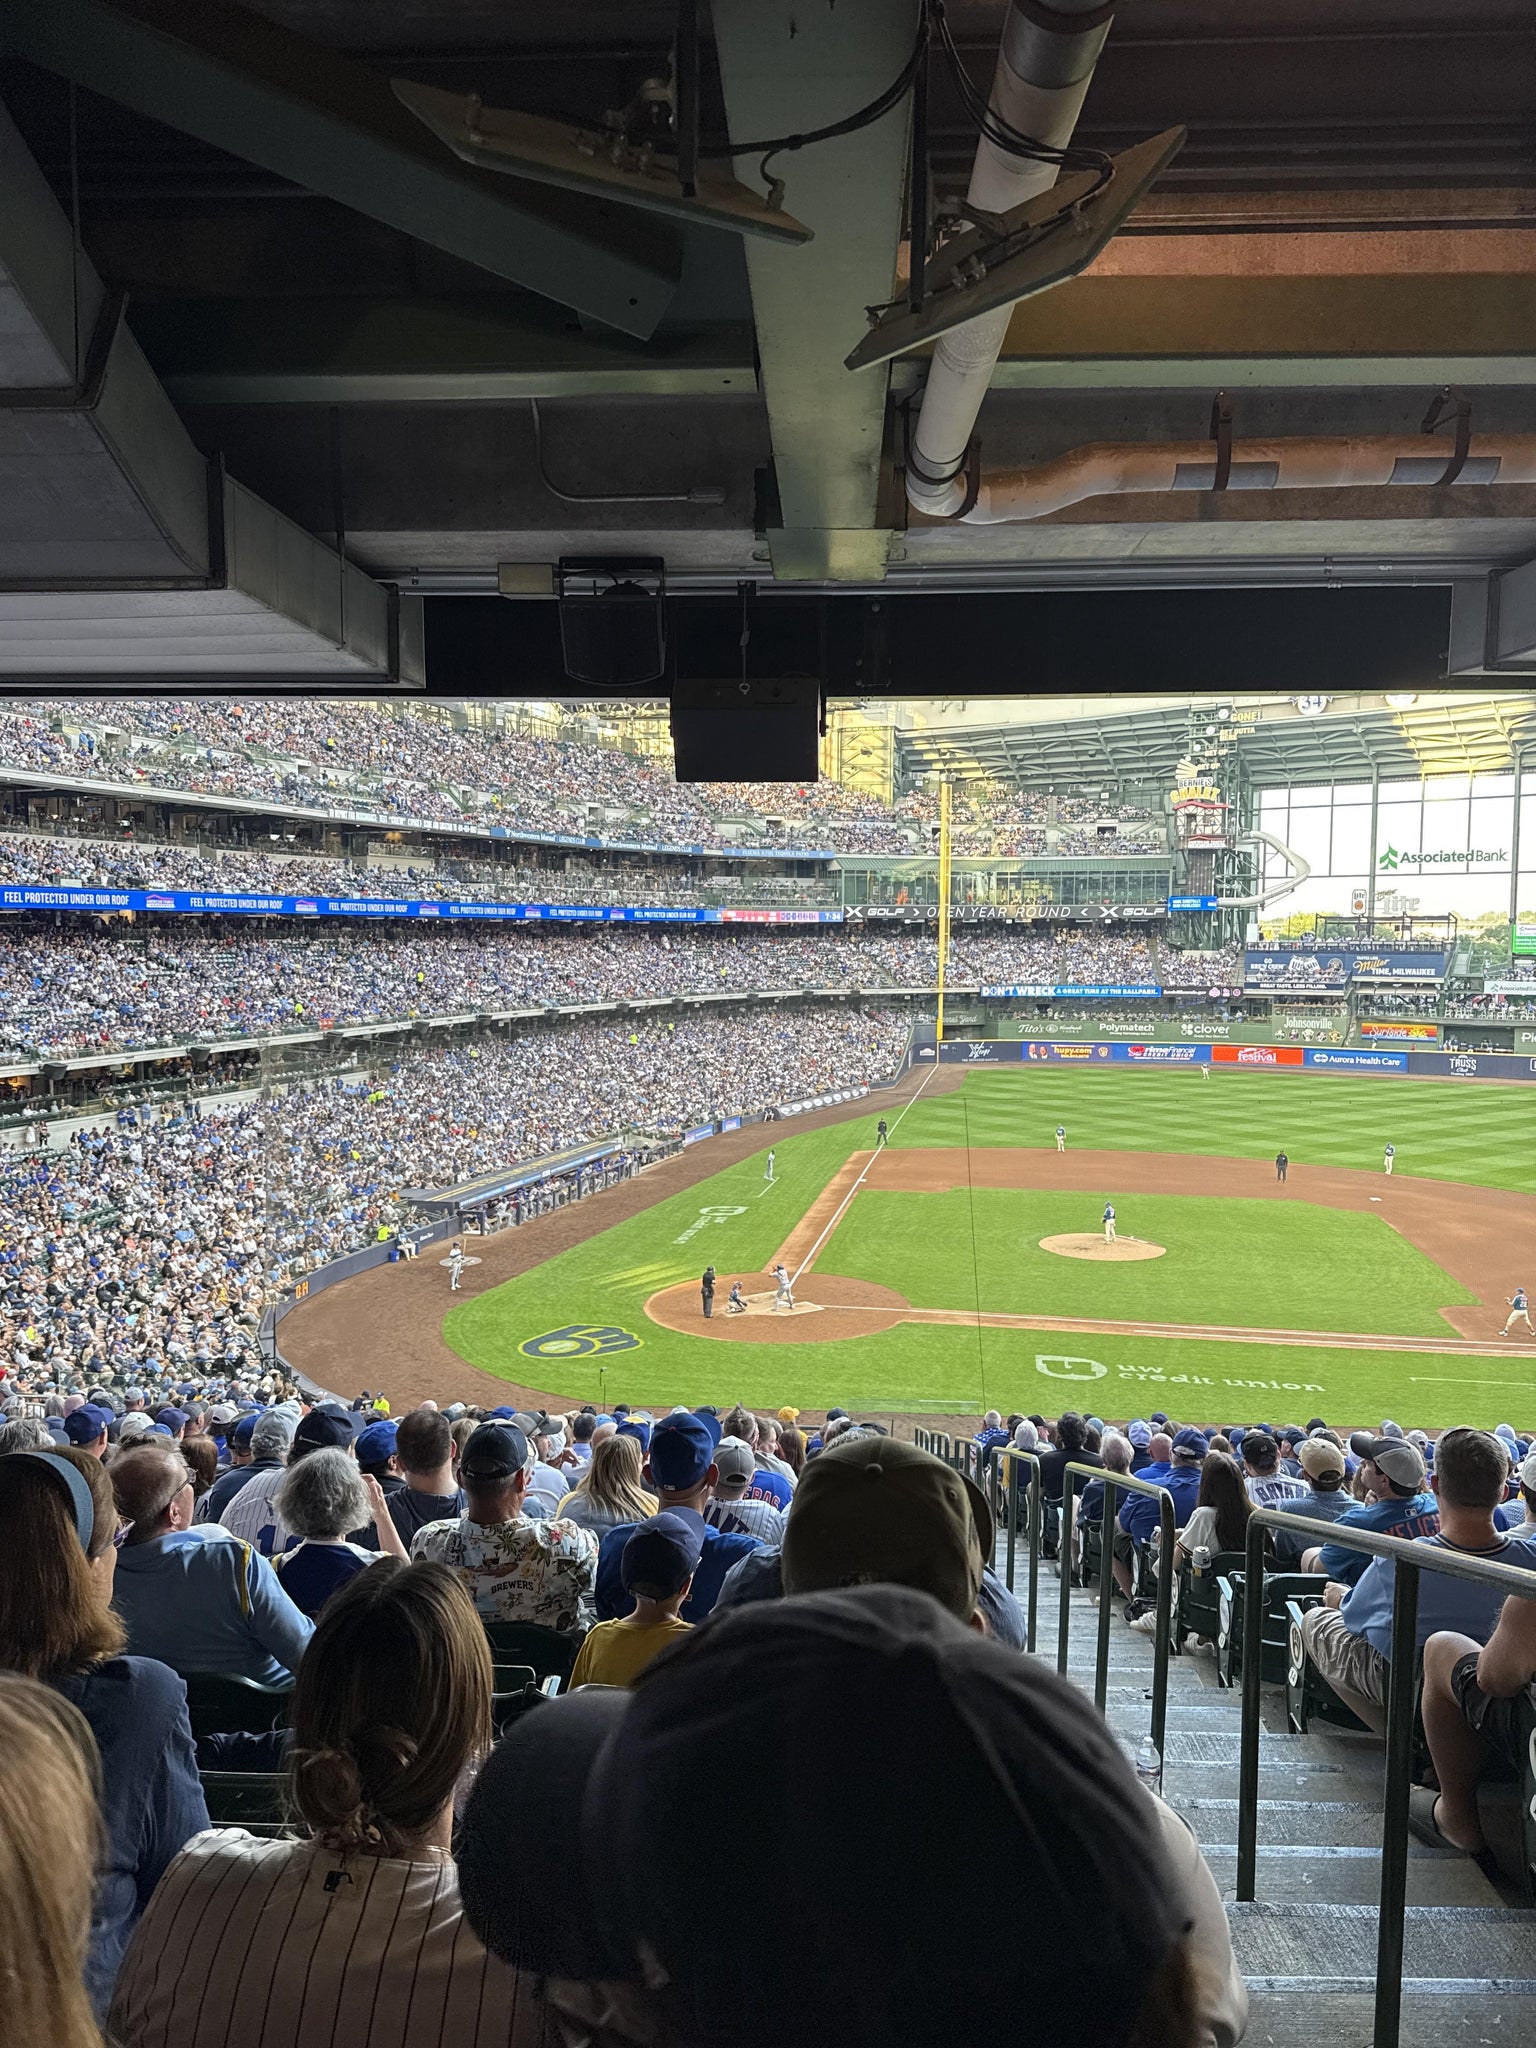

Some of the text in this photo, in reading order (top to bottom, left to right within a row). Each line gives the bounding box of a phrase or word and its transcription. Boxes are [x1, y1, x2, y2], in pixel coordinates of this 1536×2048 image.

[1170, 786, 1220, 803] CHALET
[1400, 848, 1509, 863] Associated Bank
[4, 891, 129, 905] FEEL PROTECTED UNDER OUR ROOF
[190, 898, 283, 909] FEEL PROTECTED UNDER OUR ROOF
[329, 902, 339, 911] FEEL
[341, 903, 366, 912] PROTECTED
[368, 904, 384, 912] UNDER
[845, 907, 863, 917] X
[971, 907, 1007, 917] YEAR
[1016, 907, 1071, 917] ROUND
[1100, 907, 1119, 917] X
[1353, 959, 1390, 974] Miller
[982, 987, 1056, 996] DON'T WRECK
[1100, 1024, 1154, 1032] Polymatech
[1284, 1017, 1332, 1029] Johnsonville
[1018, 1024, 1044, 1034] Tito's
[1194, 1024, 1229, 1034] clover
[1370, 1026, 1407, 1038] Surfside
[1054, 1046, 1092, 1055] hupy.com
[1237, 1050, 1276, 1062] festival
[1356, 1057, 1380, 1065] Health
[1381, 1058, 1400, 1066] Care
[1449, 1058, 1476, 1070] TRUSS
[1117, 1364, 1164, 1374] uw
[1119, 1372, 1326, 1392] credit union
[742, 1486, 780, 1508] ERAS
[491, 1580, 534, 1593] BREWERS
